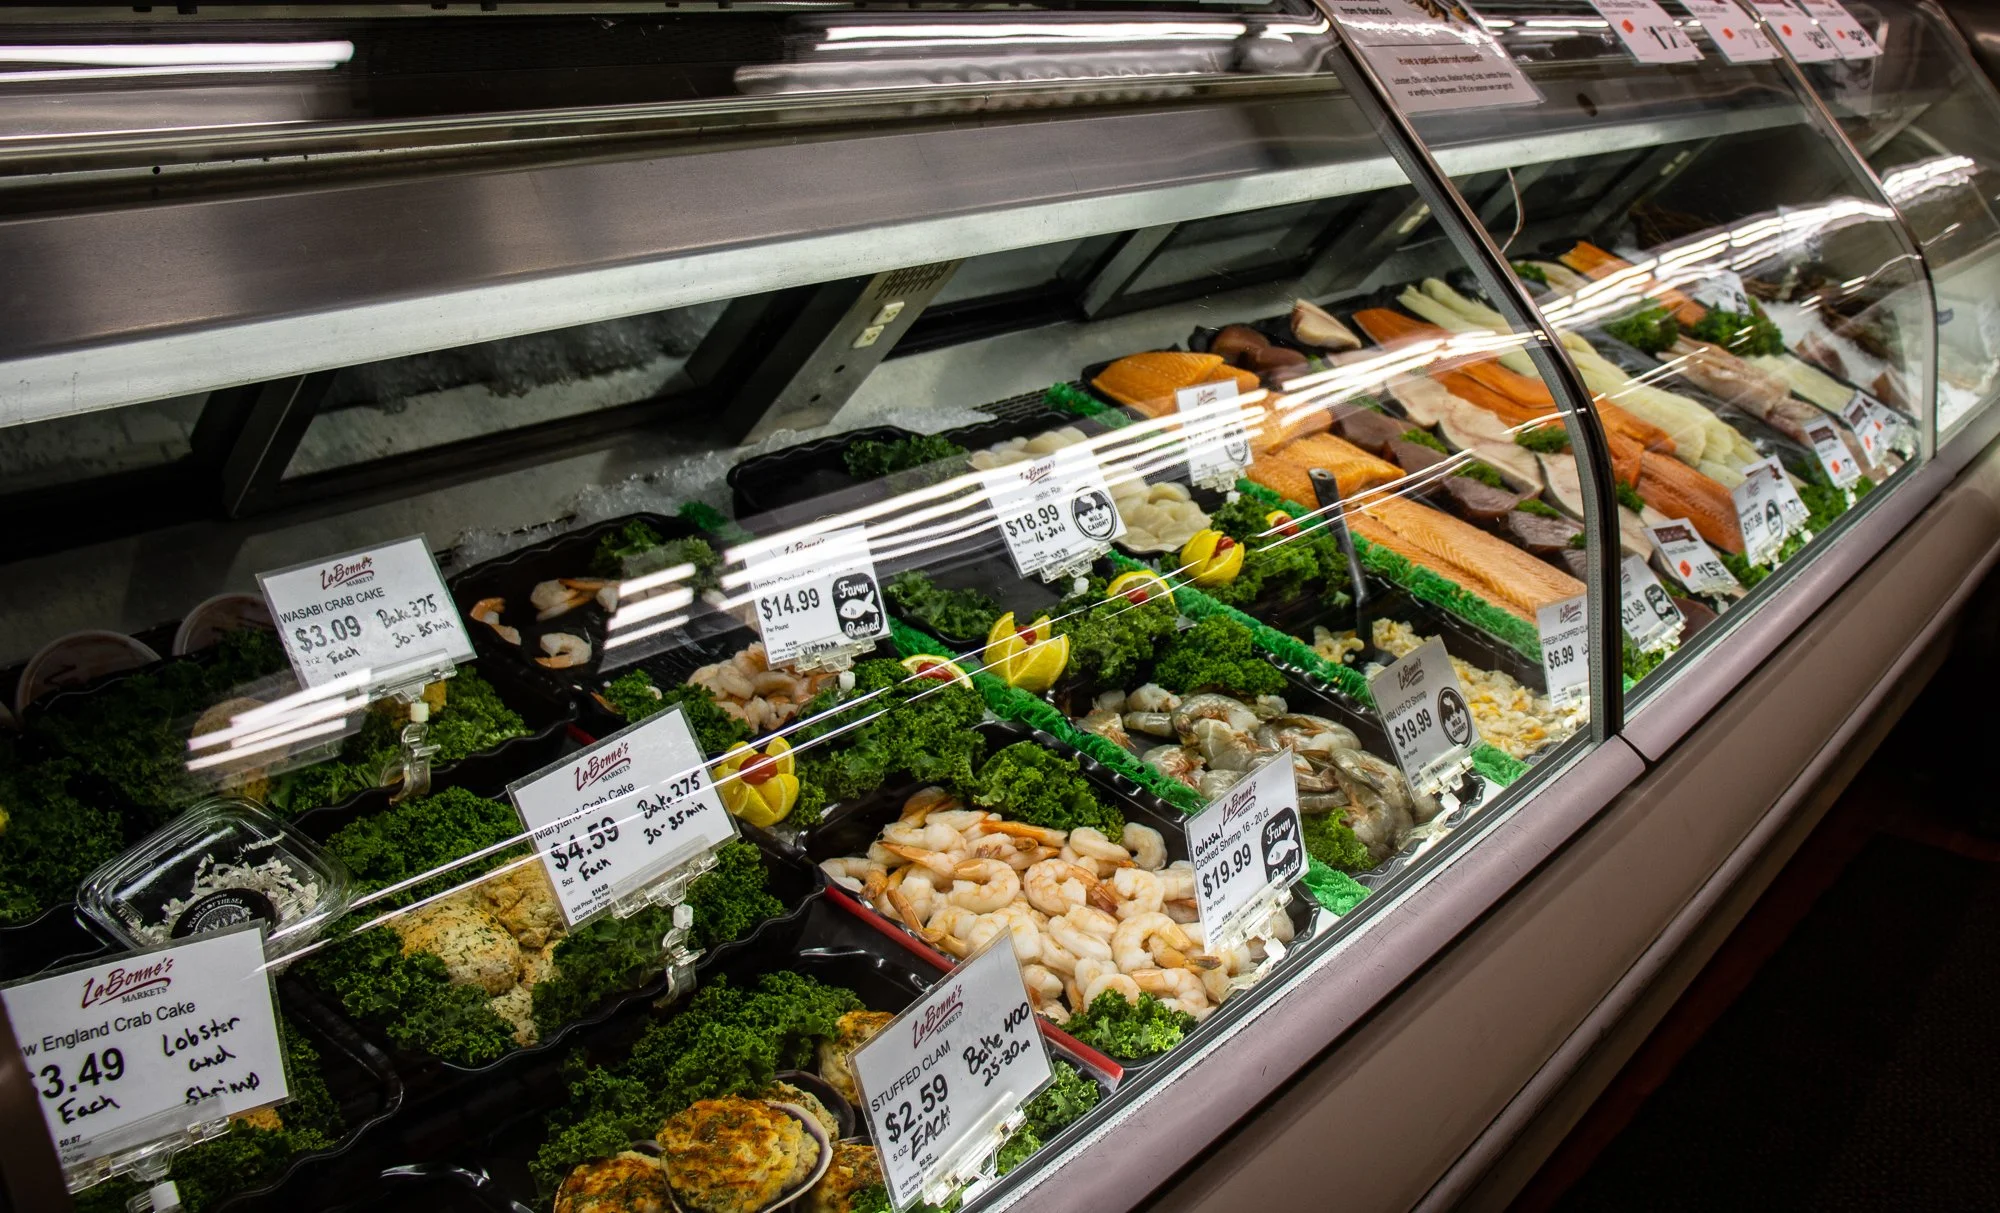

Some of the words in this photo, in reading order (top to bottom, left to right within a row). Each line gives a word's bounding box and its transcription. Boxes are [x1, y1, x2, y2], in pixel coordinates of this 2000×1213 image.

[1005, 504, 1059, 538] $18.99
[1088, 513, 1103, 523] WILD
[1088, 519, 1109, 532] CAUGHT
[319, 556, 373, 590] LaBonne's
[346, 575, 374, 587] MARKETS
[838, 580, 869, 599] Farm
[279, 603, 323, 624] WASABI
[324, 596, 355, 612] CRAB
[356, 587, 385, 603] CAKE
[376, 608, 409, 630] Bake
[409, 594, 438, 618] 375
[760, 587, 820, 622] $14.99
[295, 615, 362, 654] $3.09
[845, 613, 880, 637] Raised
[1542, 634, 1558, 647] FRESH
[1559, 627, 1580, 641] CHOPPED
[326, 646, 361, 665] Each
[1548, 645, 1574, 671] $6.99
[1395, 703, 1407, 716] U15
[1395, 708, 1432, 749] $19.99
[574, 741, 629, 792] LaBonne's
[602, 765, 631, 783] MARKETS
[608, 781, 636, 801] Cake
[671, 771, 701, 799] 375
[1222, 780, 1257, 826] LaBonne's
[550, 816, 620, 872] $4.59
[1195, 847, 1220, 872] Cooked
[1219, 830, 1242, 854] Shrimp
[1242, 821, 1251, 834] 16
[1254, 811, 1263, 825] 20
[1263, 806, 1269, 818] ct
[1266, 818, 1291, 845] Farm
[561, 877, 575, 888] 5oz
[578, 857, 613, 882] Each
[1202, 843, 1251, 900] $19.99
[202, 907, 253, 934] AVIAR
[571, 904, 582, 914] Unit
[574, 909, 592, 921] Country
[81, 957, 174, 1009] LaBonne's
[122, 985, 167, 1004] MARKETS
[43, 1020, 109, 1055] England
[114, 1010, 152, 1034] Crab
[156, 1001, 196, 1021] Cake
[913, 984, 962, 1049] LaBonne's
[936, 1010, 963, 1035] MARKETS
[162, 1017, 240, 1057] Lobster
[962, 1032, 1004, 1076] Bake
[1003, 1001, 1030, 1034] 400
[189, 1045, 236, 1073] and
[30, 1047, 125, 1100] 3.49
[871, 1065, 921, 1113] STUFFED
[922, 1040, 951, 1073] CLAM
[57, 1095, 121, 1125] Each
[884, 1073, 949, 1144] $2.59
[60, 1134, 81, 1148] $0.87
[892, 1152, 898, 1162] 5
[898, 1144, 910, 1157] OZ
[902, 1182, 919, 1199] Country
